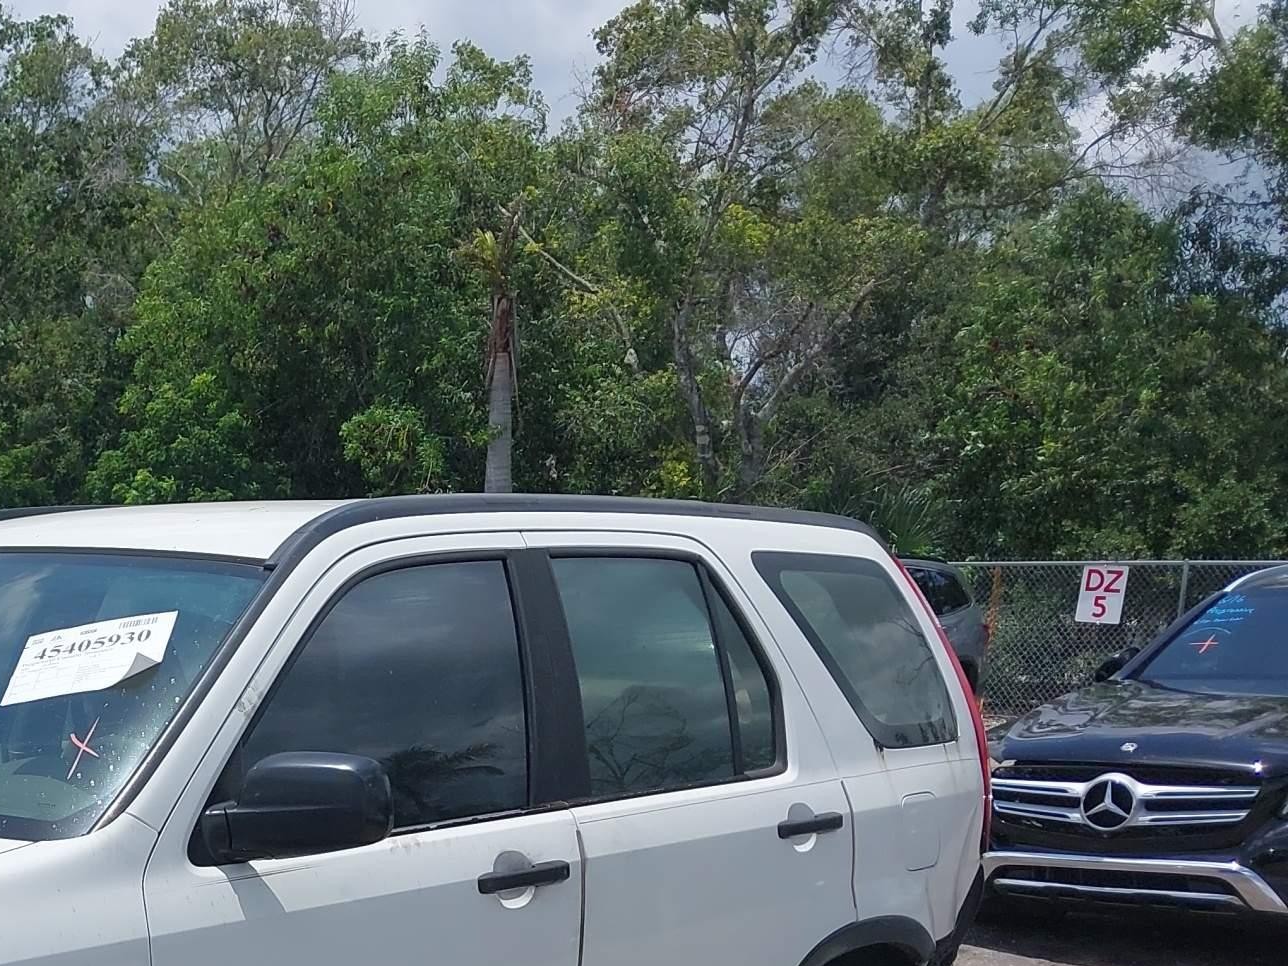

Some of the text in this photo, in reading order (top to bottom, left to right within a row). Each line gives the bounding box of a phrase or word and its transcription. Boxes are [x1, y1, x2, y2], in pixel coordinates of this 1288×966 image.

[1085, 569, 1124, 593] DZ
[1092, 595, 1107, 618] 5
[34, 629, 152, 660] 45405930
